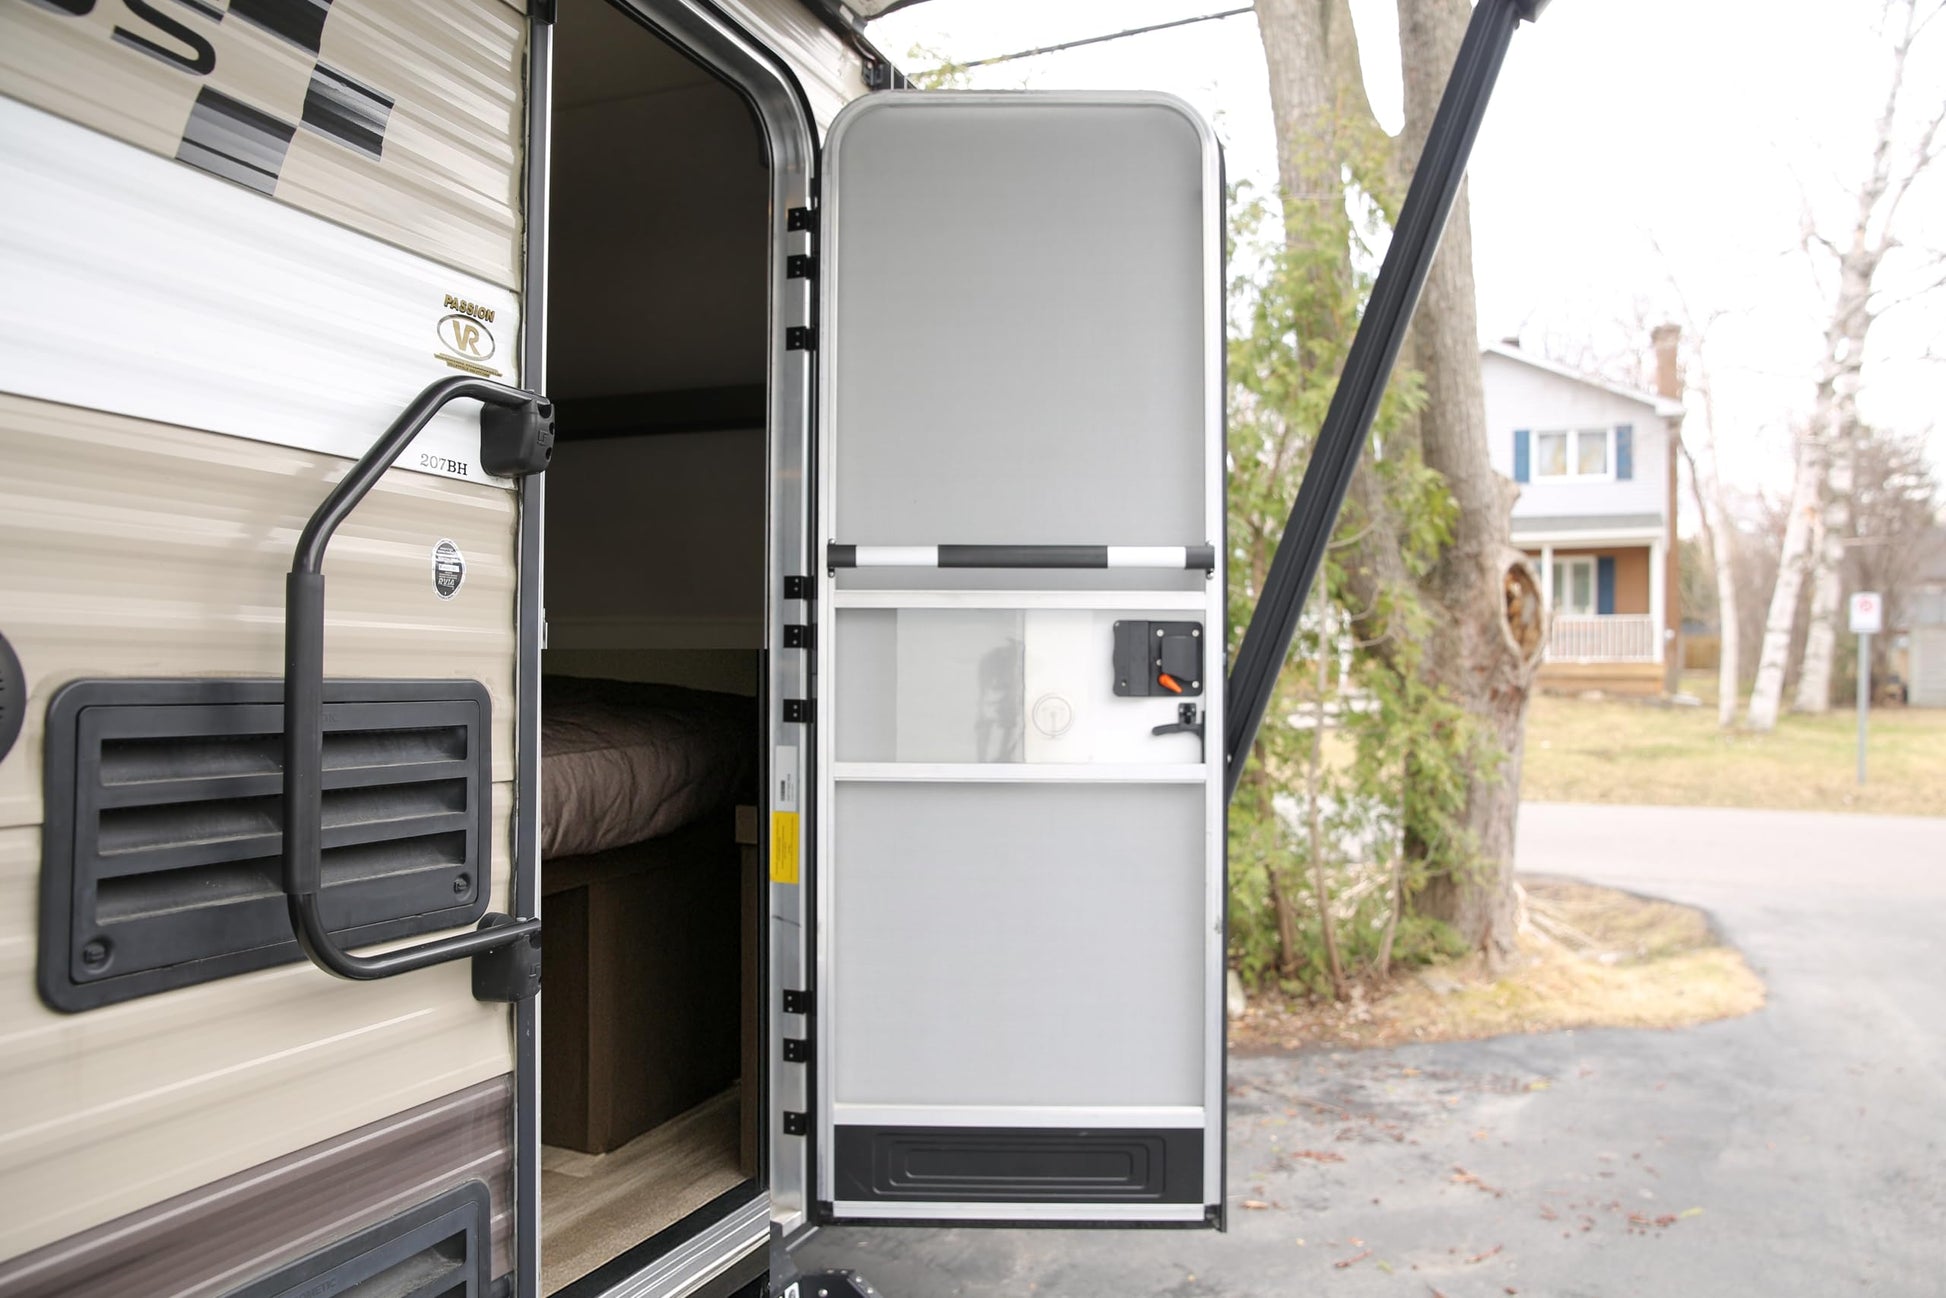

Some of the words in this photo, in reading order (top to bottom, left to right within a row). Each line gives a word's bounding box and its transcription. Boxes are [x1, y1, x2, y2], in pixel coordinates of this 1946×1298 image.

[443, 293, 496, 323] PASSION
[452, 320, 481, 356] VR
[420, 453, 468, 476] 207BH
